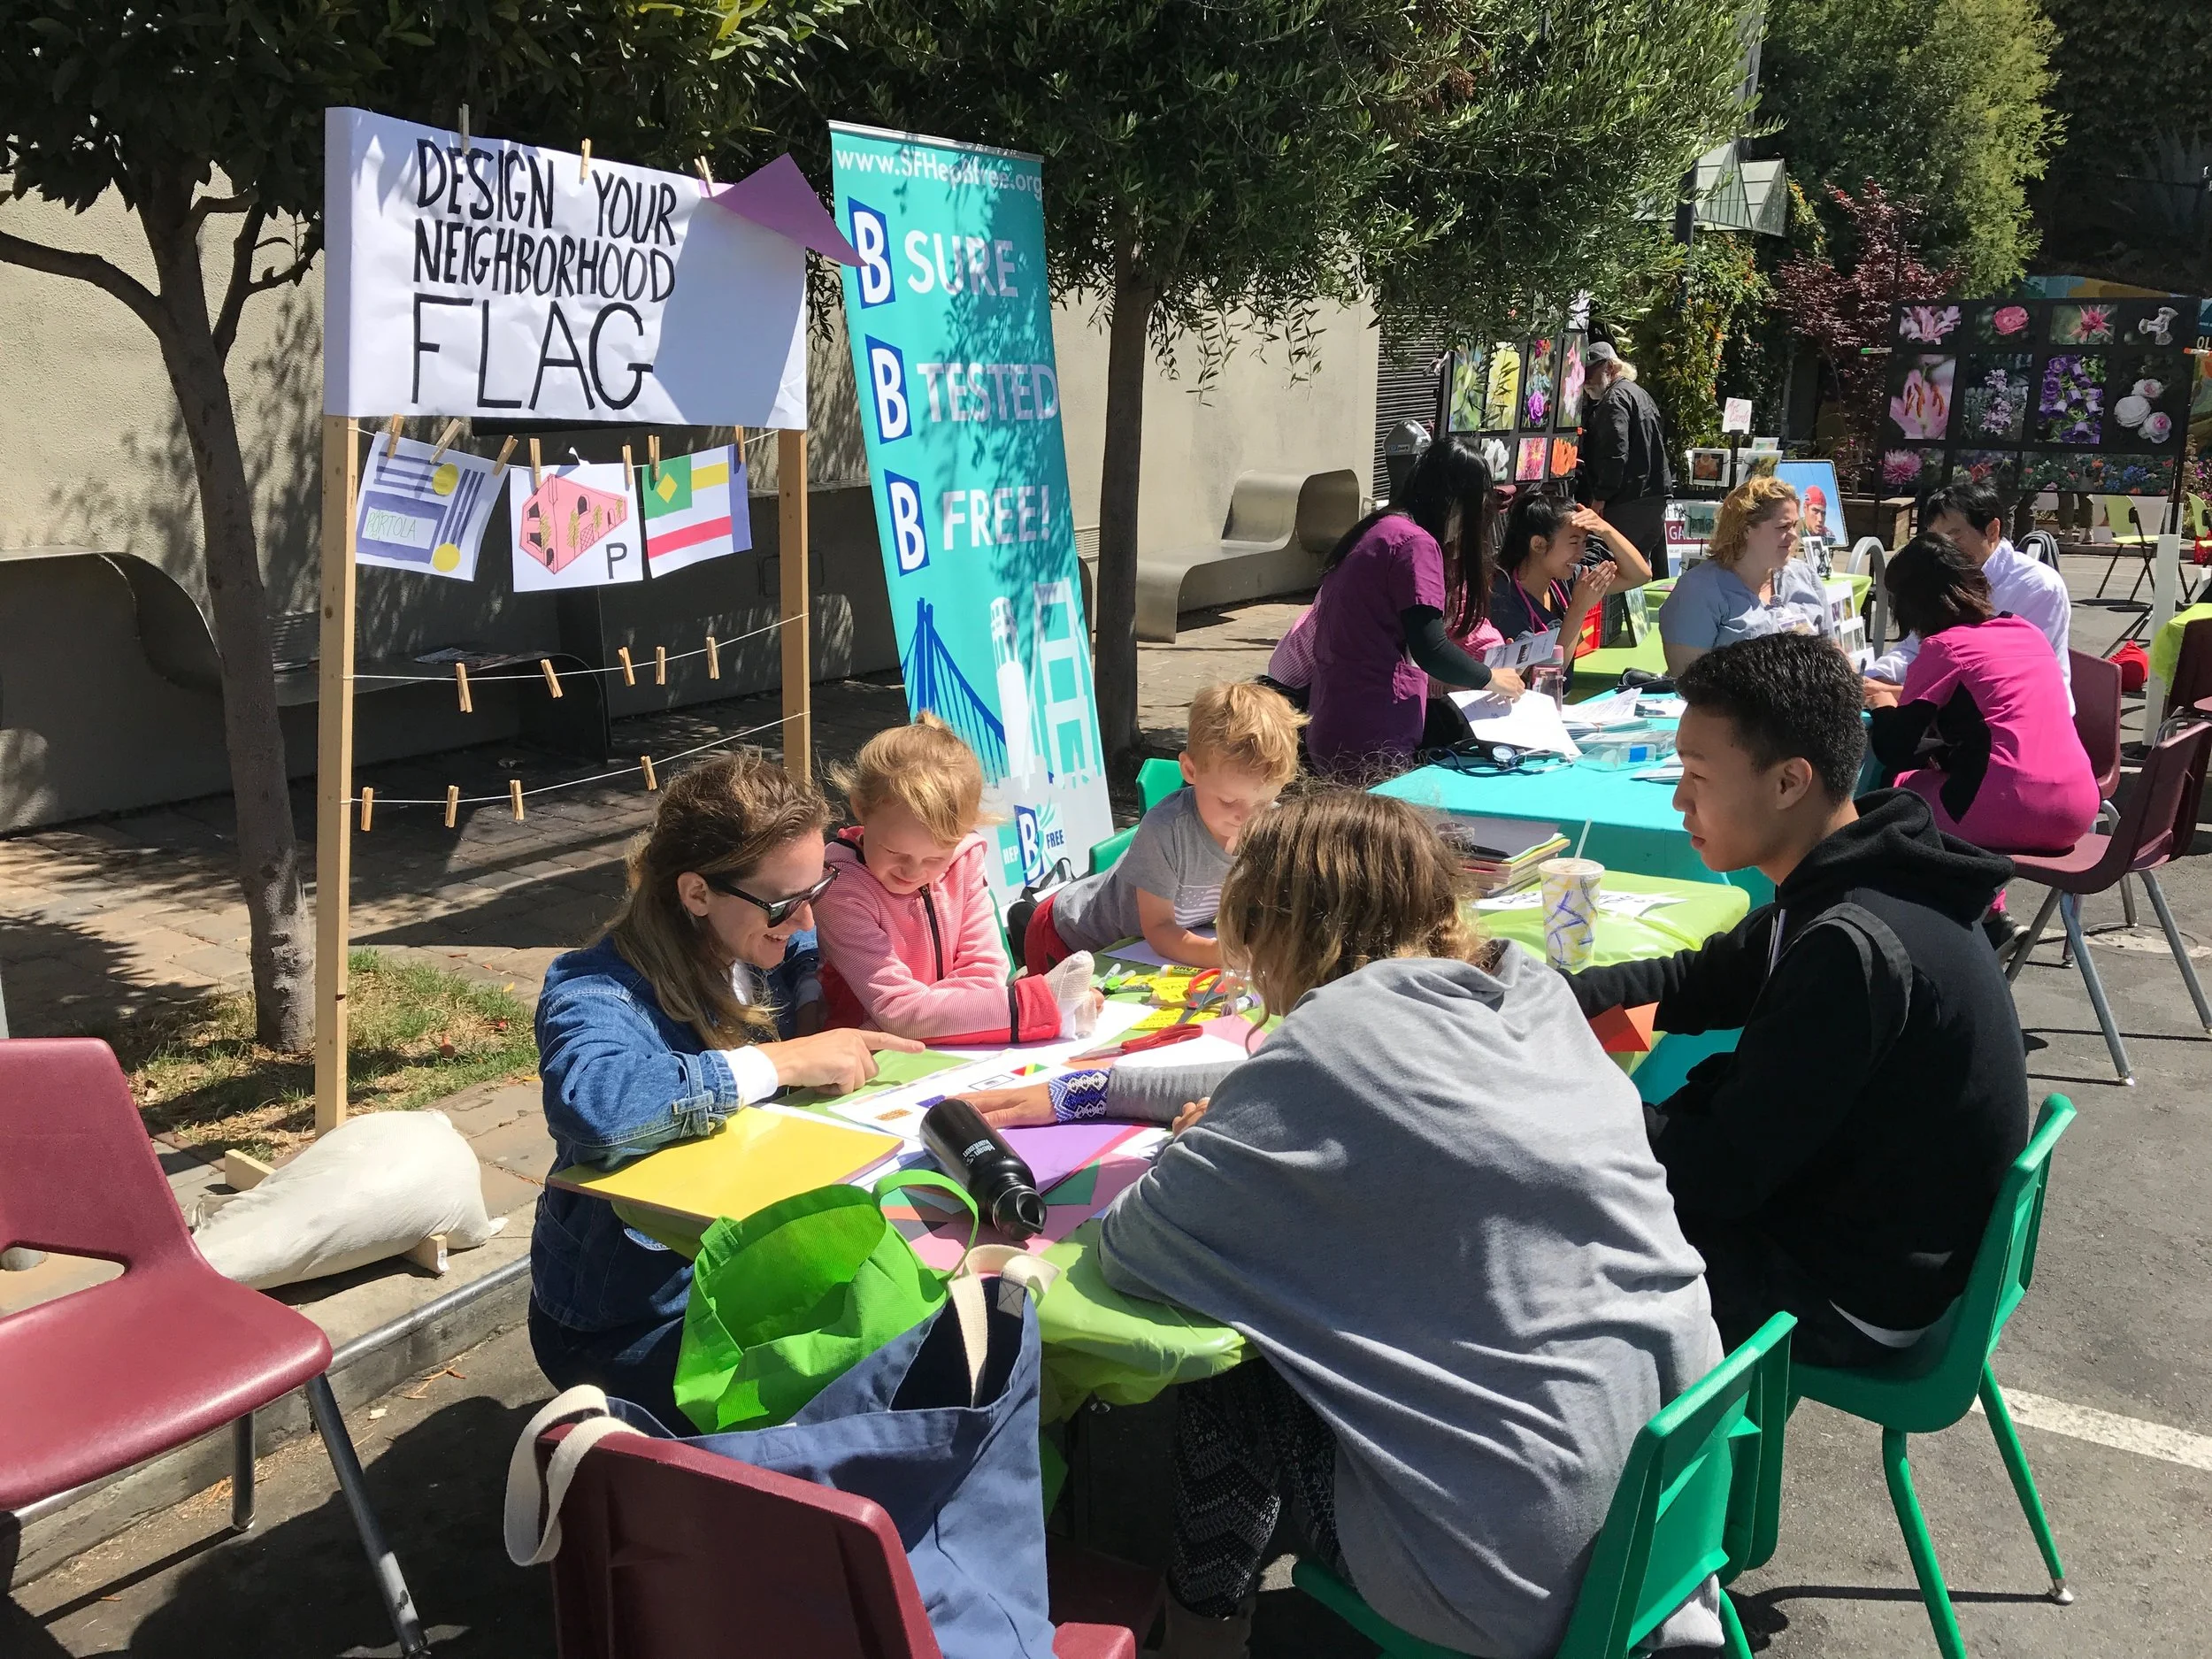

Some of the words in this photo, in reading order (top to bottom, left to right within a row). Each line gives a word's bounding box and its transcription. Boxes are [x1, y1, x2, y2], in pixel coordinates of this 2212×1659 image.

[417, 138, 554, 229] DESIGN
[591, 169, 678, 247] YOUR
[412, 218, 676, 303] NEIGHBORHOOD
[853, 211, 892, 304] B
[903, 229, 1019, 298] SURE
[411, 292, 655, 411] FLAG
[871, 348, 909, 440] B
[916, 362, 1060, 424] TESTED
[605, 541, 628, 580] P
[890, 481, 926, 572] B
[941, 484, 1050, 551] FREE!
[1002, 845, 1018, 865] HEP
[1045, 829, 1065, 849] FREE
